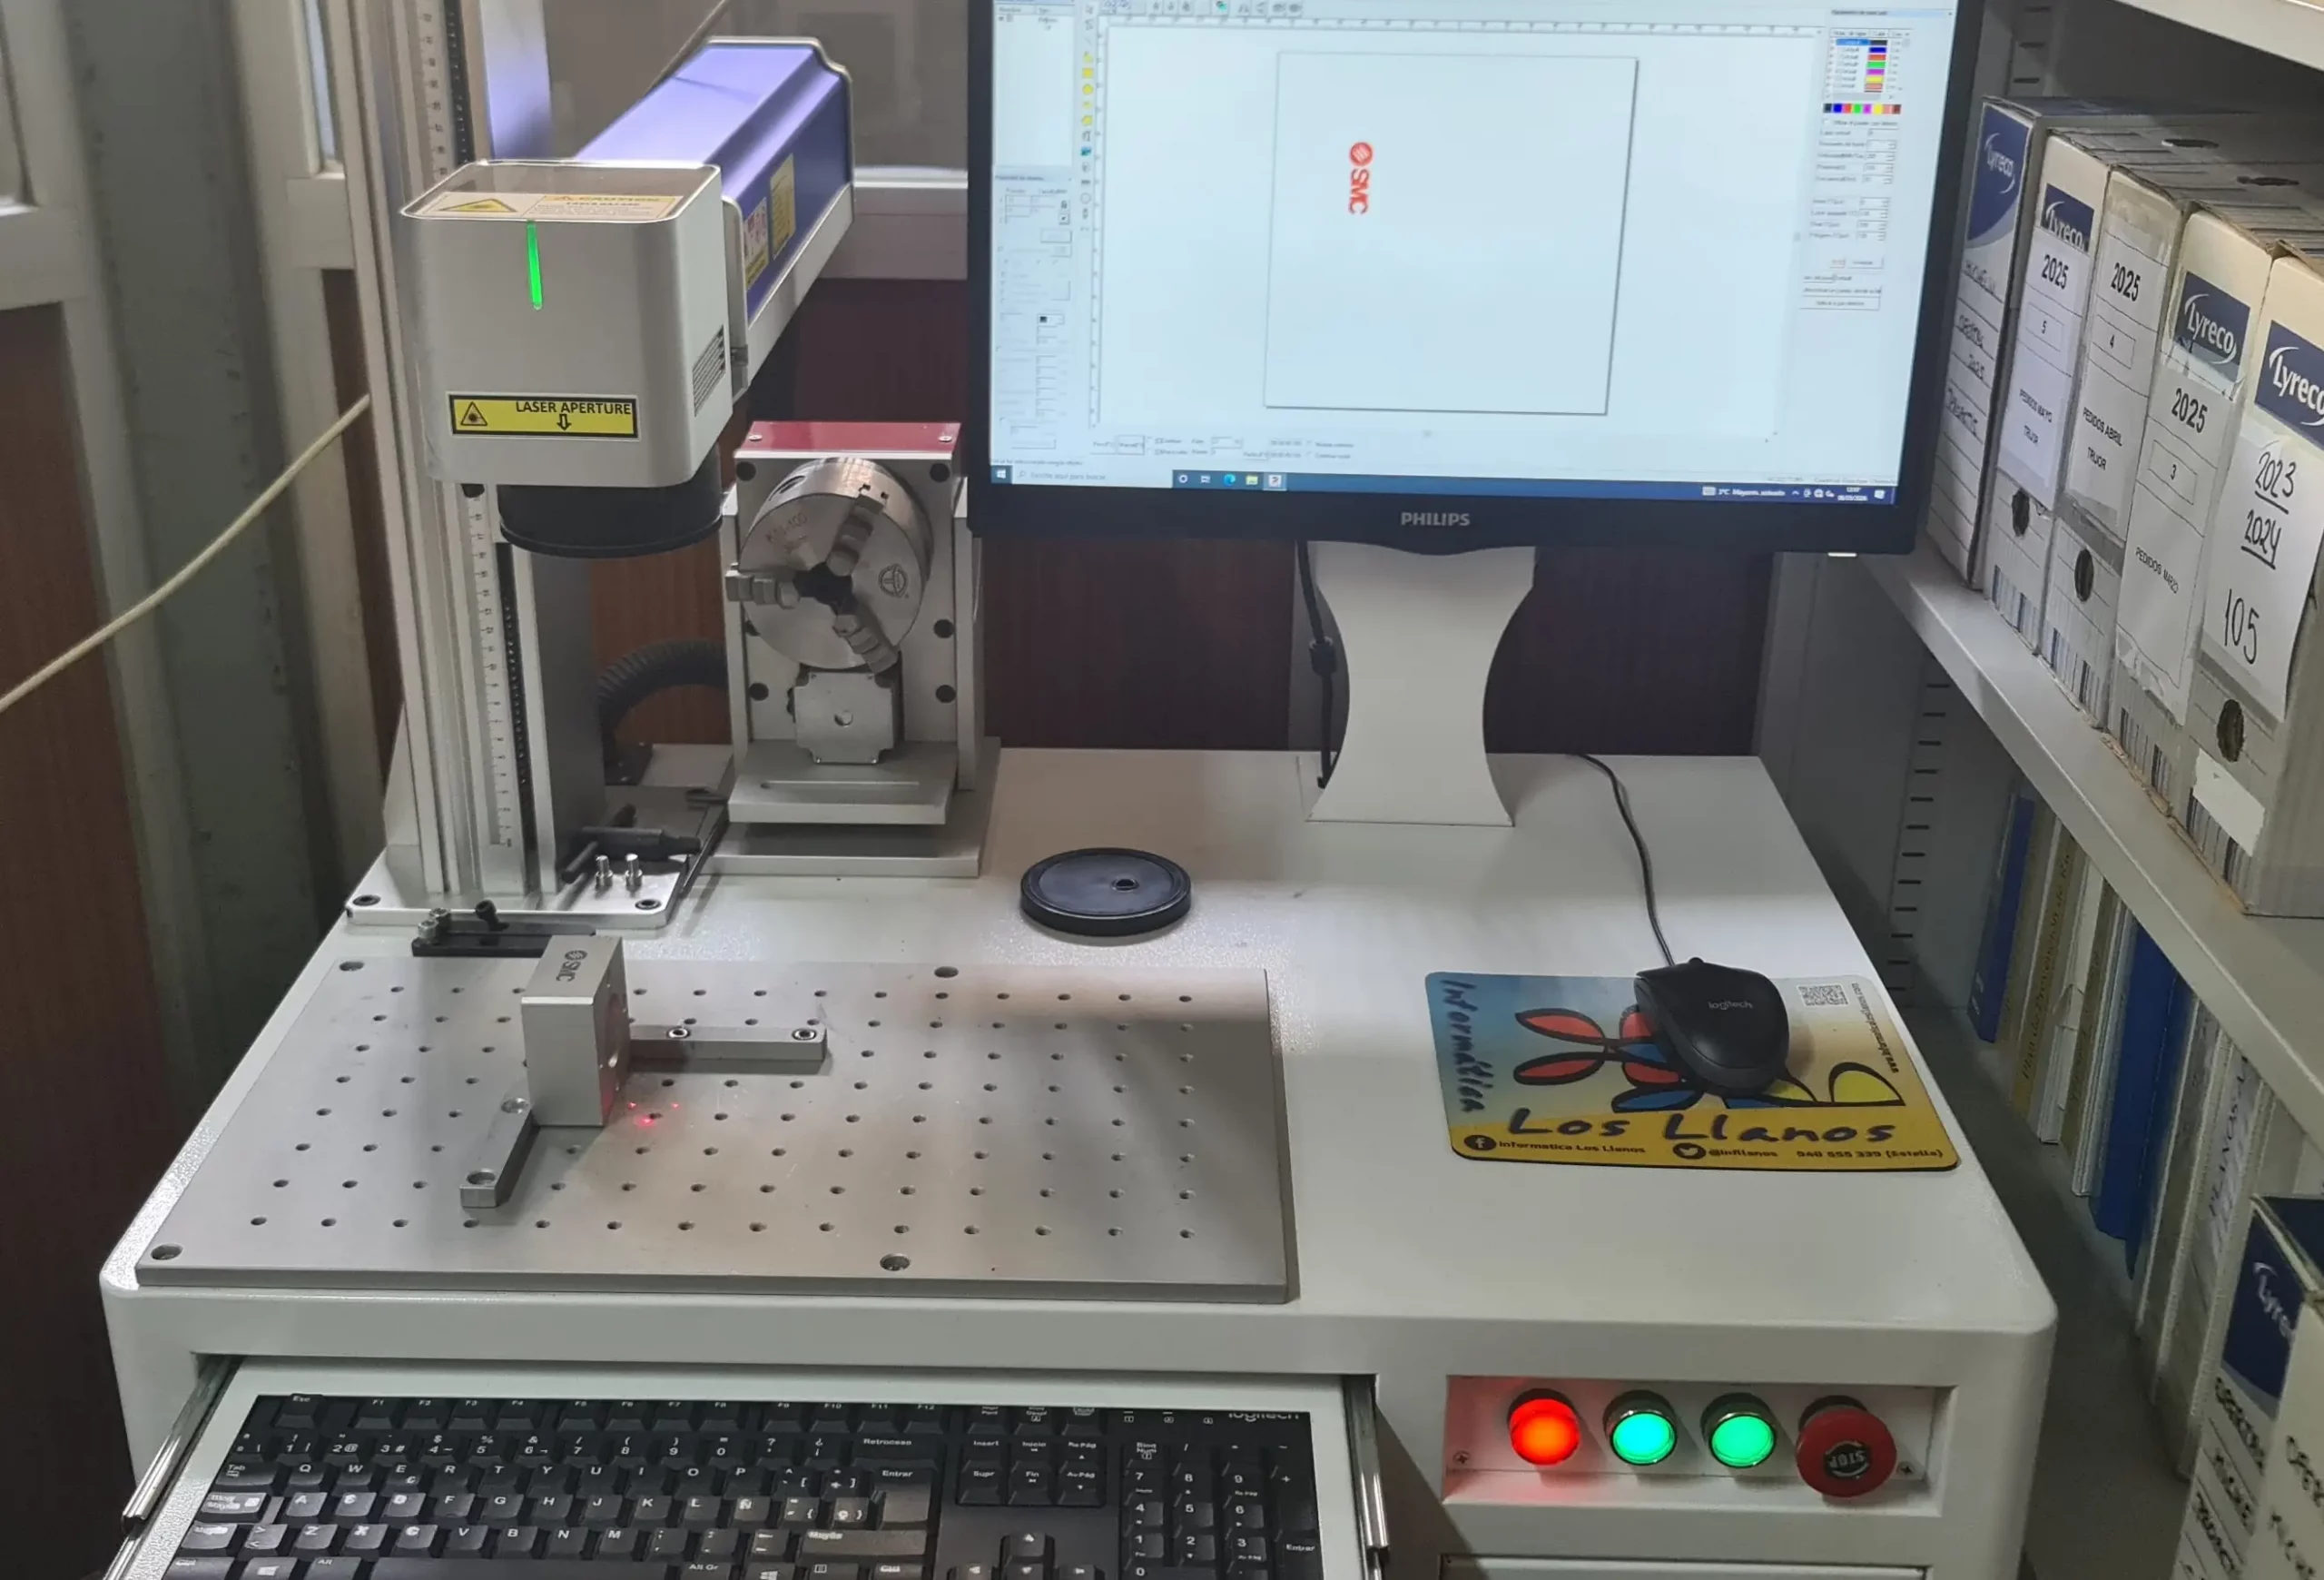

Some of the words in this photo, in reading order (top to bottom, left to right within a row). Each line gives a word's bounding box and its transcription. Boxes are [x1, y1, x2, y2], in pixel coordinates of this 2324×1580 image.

[2041, 254, 2069, 290] 2025
[2111, 262, 2141, 301] 2025
[2041, 320, 2047, 334] 5
[2187, 302, 2234, 354] Lyreco
[2109, 334, 2115, 349] 4
[2272, 354, 2324, 416] Lyreco
[516, 400, 557, 413] LASER
[560, 402, 632, 415] APERTURE
[2171, 388, 2208, 433] 2025
[2170, 464, 2177, 480] 3
[2255, 451, 2297, 499] 2023
[1401, 511, 1471, 527] PHILIPS
[2245, 509, 2281, 565] 2024
[2135, 547, 2162, 575] PEDIDOS
[2224, 588, 2260, 665] 105
[1708, 1000, 1753, 1011] logitech
[1508, 1107, 1630, 1137] Los
[1662, 1113, 1896, 1142] Llanos
[1576, 1144, 1600, 1152] Los
[1603, 1145, 1646, 1153] Llanos
[481, 1436, 494, 1444] %
[528, 1436, 538, 1444] &
[332, 1445, 343, 1453] 2
[477, 1446, 487, 1454] 5
[525, 1446, 534, 1454] 6
[574, 1447, 584, 1455] 7
[621, 1447, 630, 1455] 8
[669, 1447, 679, 1456] 9
[716, 1447, 726, 1456] 0
[1828, 1450, 1866, 1469] STOP
[300, 1464, 312, 1473] Q
[349, 1464, 364, 1473] W
[396, 1465, 407, 1473] E
[445, 1466, 456, 1474] R
[494, 1466, 505, 1474] T
[543, 1466, 553, 1475] Y
[590, 1466, 603, 1475] U
[638, 1466, 644, 1476] I
[687, 1467, 699, 1476] O
[735, 1467, 746, 1476] P
[973, 1470, 996, 1478] Supr
[1136, 1472, 1144, 1480] 7
[1185, 1474, 1194, 1482] 8
[1235, 1475, 1243, 1484] 9
[295, 1495, 308, 1504] A
[445, 1496, 455, 1504] F
[494, 1496, 507, 1506] G
[543, 1497, 555, 1506] H
[593, 1498, 603, 1507] J
[642, 1498, 654, 1507] K
[691, 1498, 702, 1508] L
[1136, 1504, 1145, 1512] 4
[1186, 1504, 1194, 1513] 5
[1236, 1506, 1244, 1515] 6
[305, 1526, 320, 1536] Z
[354, 1526, 369, 1536] X
[458, 1527, 469, 1536] V
[507, 1528, 518, 1537] B
[557, 1530, 570, 1539] N
[608, 1530, 621, 1539] M
[1136, 1536, 1143, 1544] 1
[1187, 1536, 1196, 1545] 2
[1237, 1538, 1246, 1547] 3
[1286, 1544, 1315, 1552] Entrar
[1136, 1567, 1145, 1576] 0
